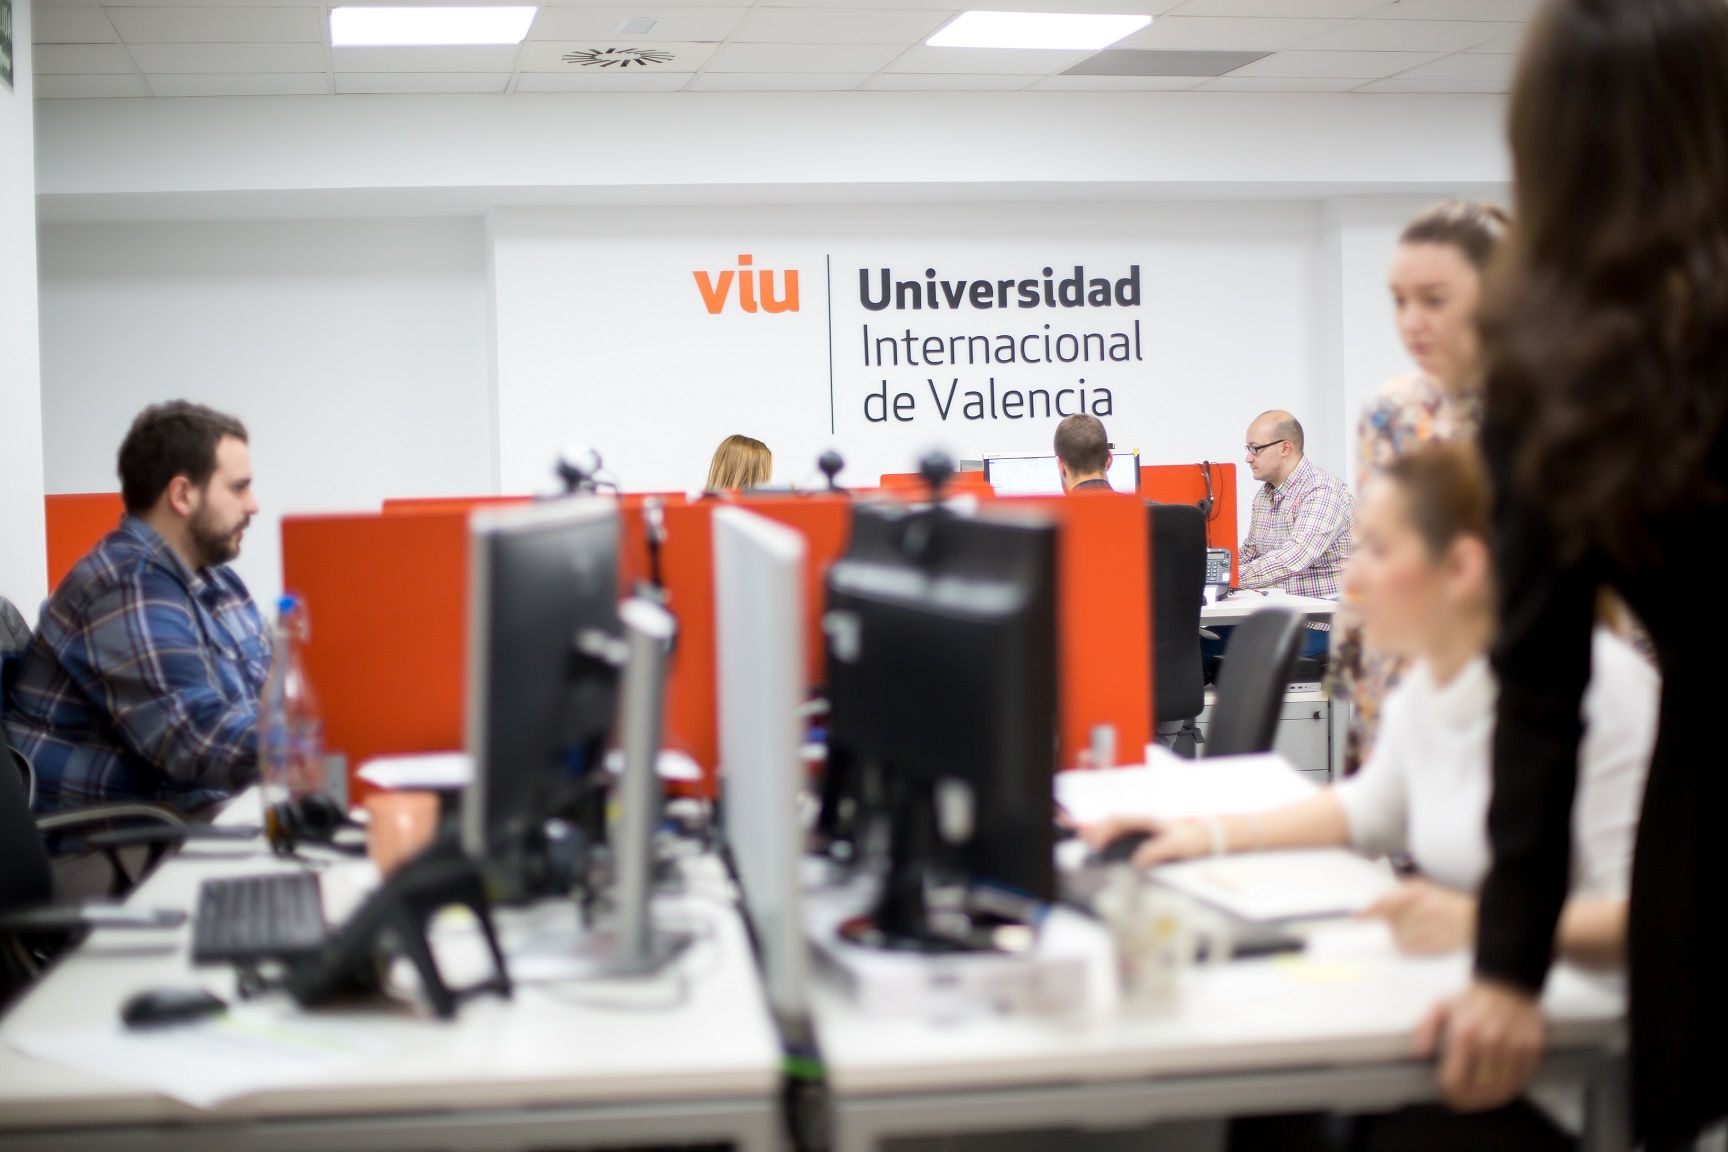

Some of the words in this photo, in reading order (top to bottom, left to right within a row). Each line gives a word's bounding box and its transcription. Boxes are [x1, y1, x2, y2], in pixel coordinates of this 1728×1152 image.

[693, 254, 800, 314] viu
[859, 265, 1141, 311] Universidad
[863, 319, 1143, 367] Internacional
[863, 379, 916, 423] de
[927, 377, 1114, 421] Valencia
